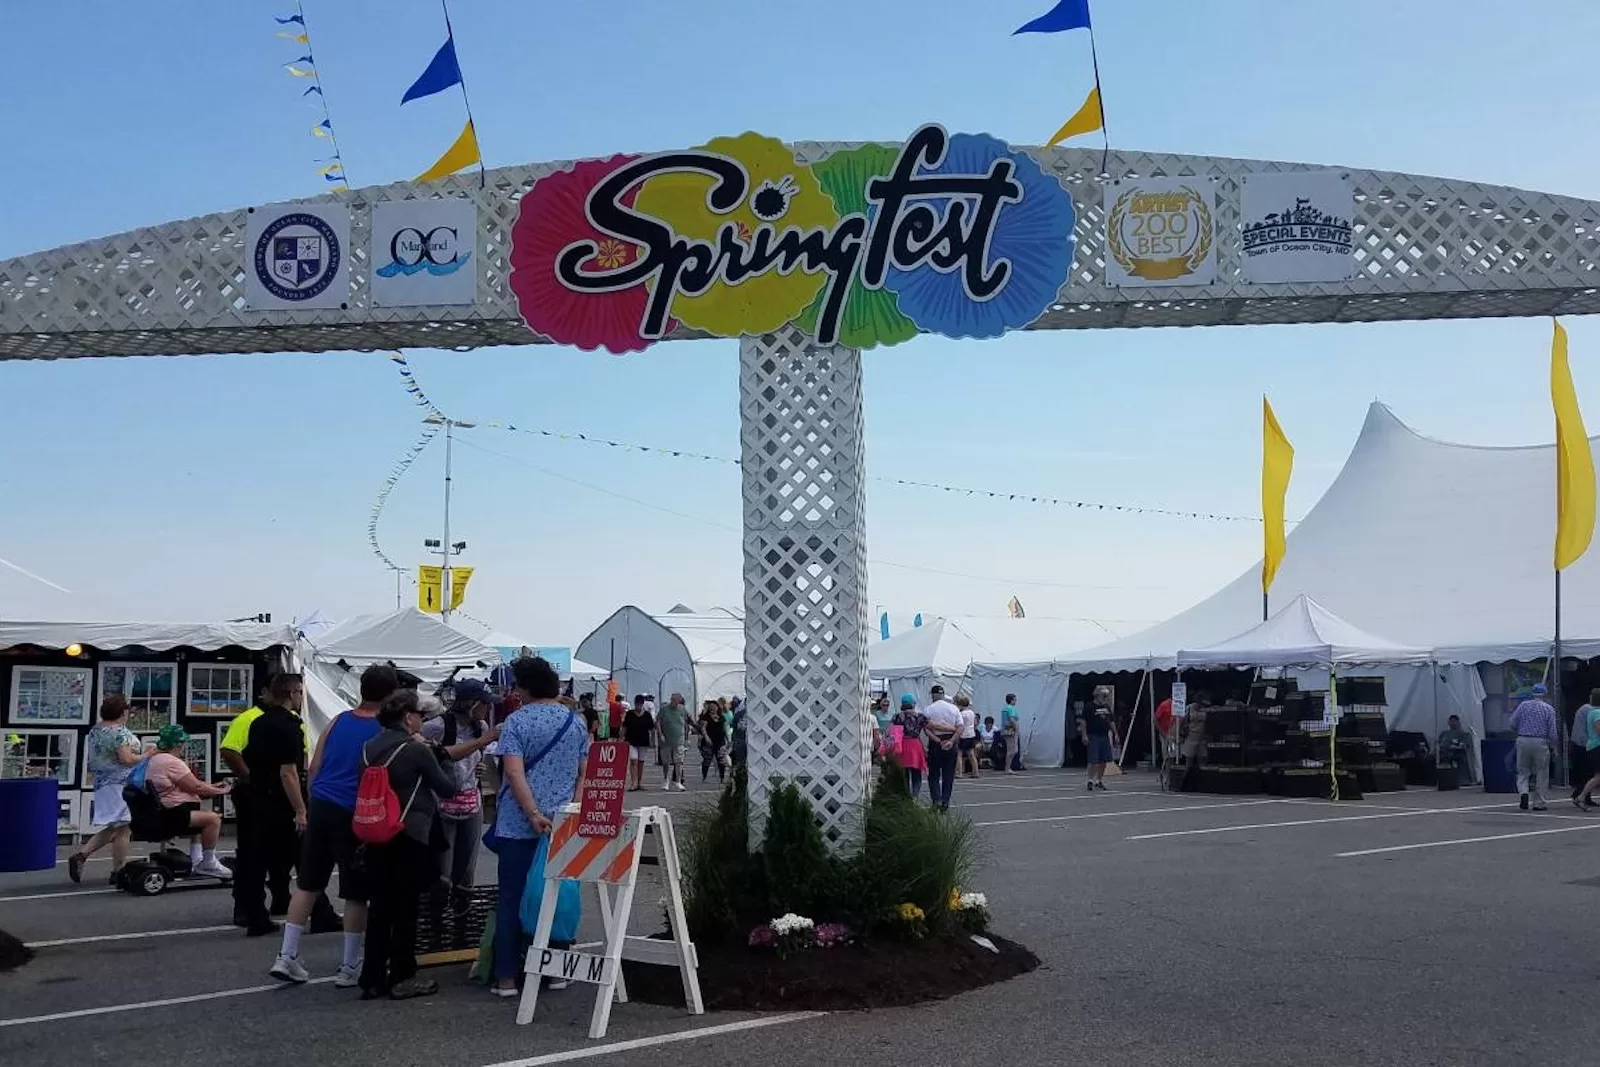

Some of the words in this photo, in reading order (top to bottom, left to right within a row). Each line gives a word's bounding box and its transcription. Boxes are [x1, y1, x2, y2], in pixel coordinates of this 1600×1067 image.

[300, 216, 320, 226] CITY
[1130, 212, 1188, 236] 200
[555, 123, 1023, 347] Springfest
[1242, 226, 1297, 246] SPECIAL
[1300, 226, 1352, 243] EVENTS
[390, 226, 458, 266] OC
[401, 239, 448, 253] Maryland
[1138, 235, 1187, 254] BEST
[1245, 248, 1268, 257] Town
[1281, 243, 1311, 252] Ocean
[1312, 243, 1334, 255] City,
[1335, 246, 1350, 255] MD
[600, 744, 616, 763] NO
[596, 767, 614, 777] BIKES
[583, 779, 624, 789] SKATEBOARDS
[588, 790, 598, 800] OR
[600, 790, 617, 800] PETS
[595, 801, 607, 811] ON
[586, 811, 612, 823] EVENT
[578, 823, 617, 836] GROUNDS
